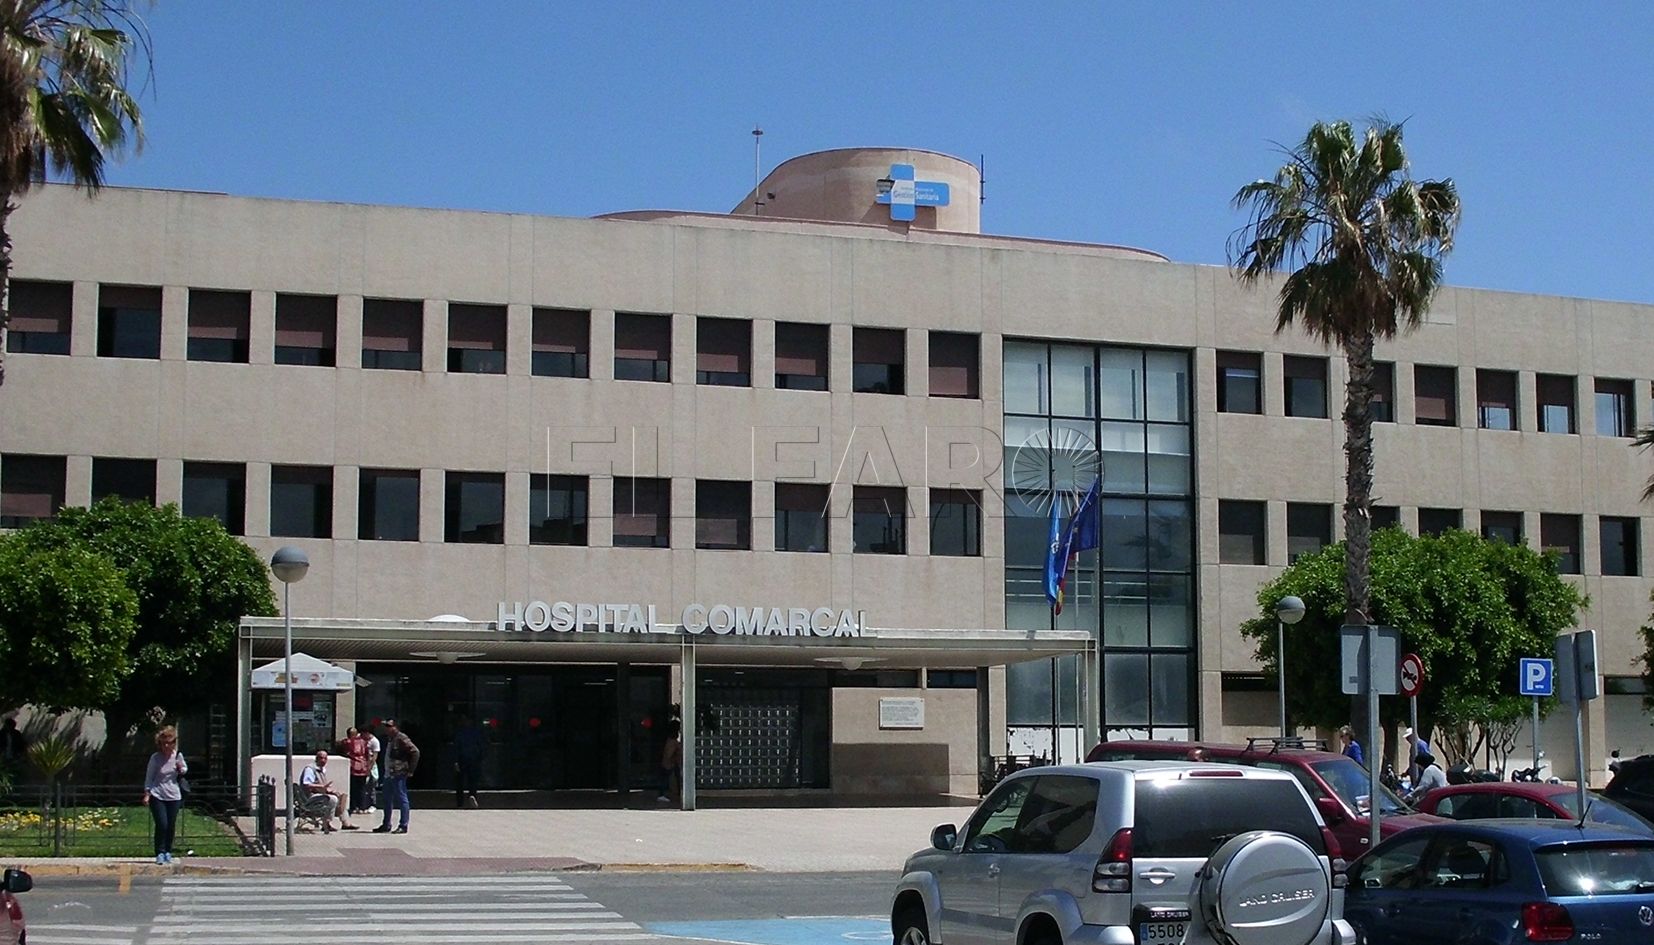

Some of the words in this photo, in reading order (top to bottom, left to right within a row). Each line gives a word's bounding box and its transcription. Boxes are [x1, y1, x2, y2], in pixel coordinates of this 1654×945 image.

[498, 600, 668, 633] HOSPITAL
[682, 603, 876, 637] COMARCAL
[1526, 662, 1546, 690] P
[1148, 923, 1184, 939] 5508
